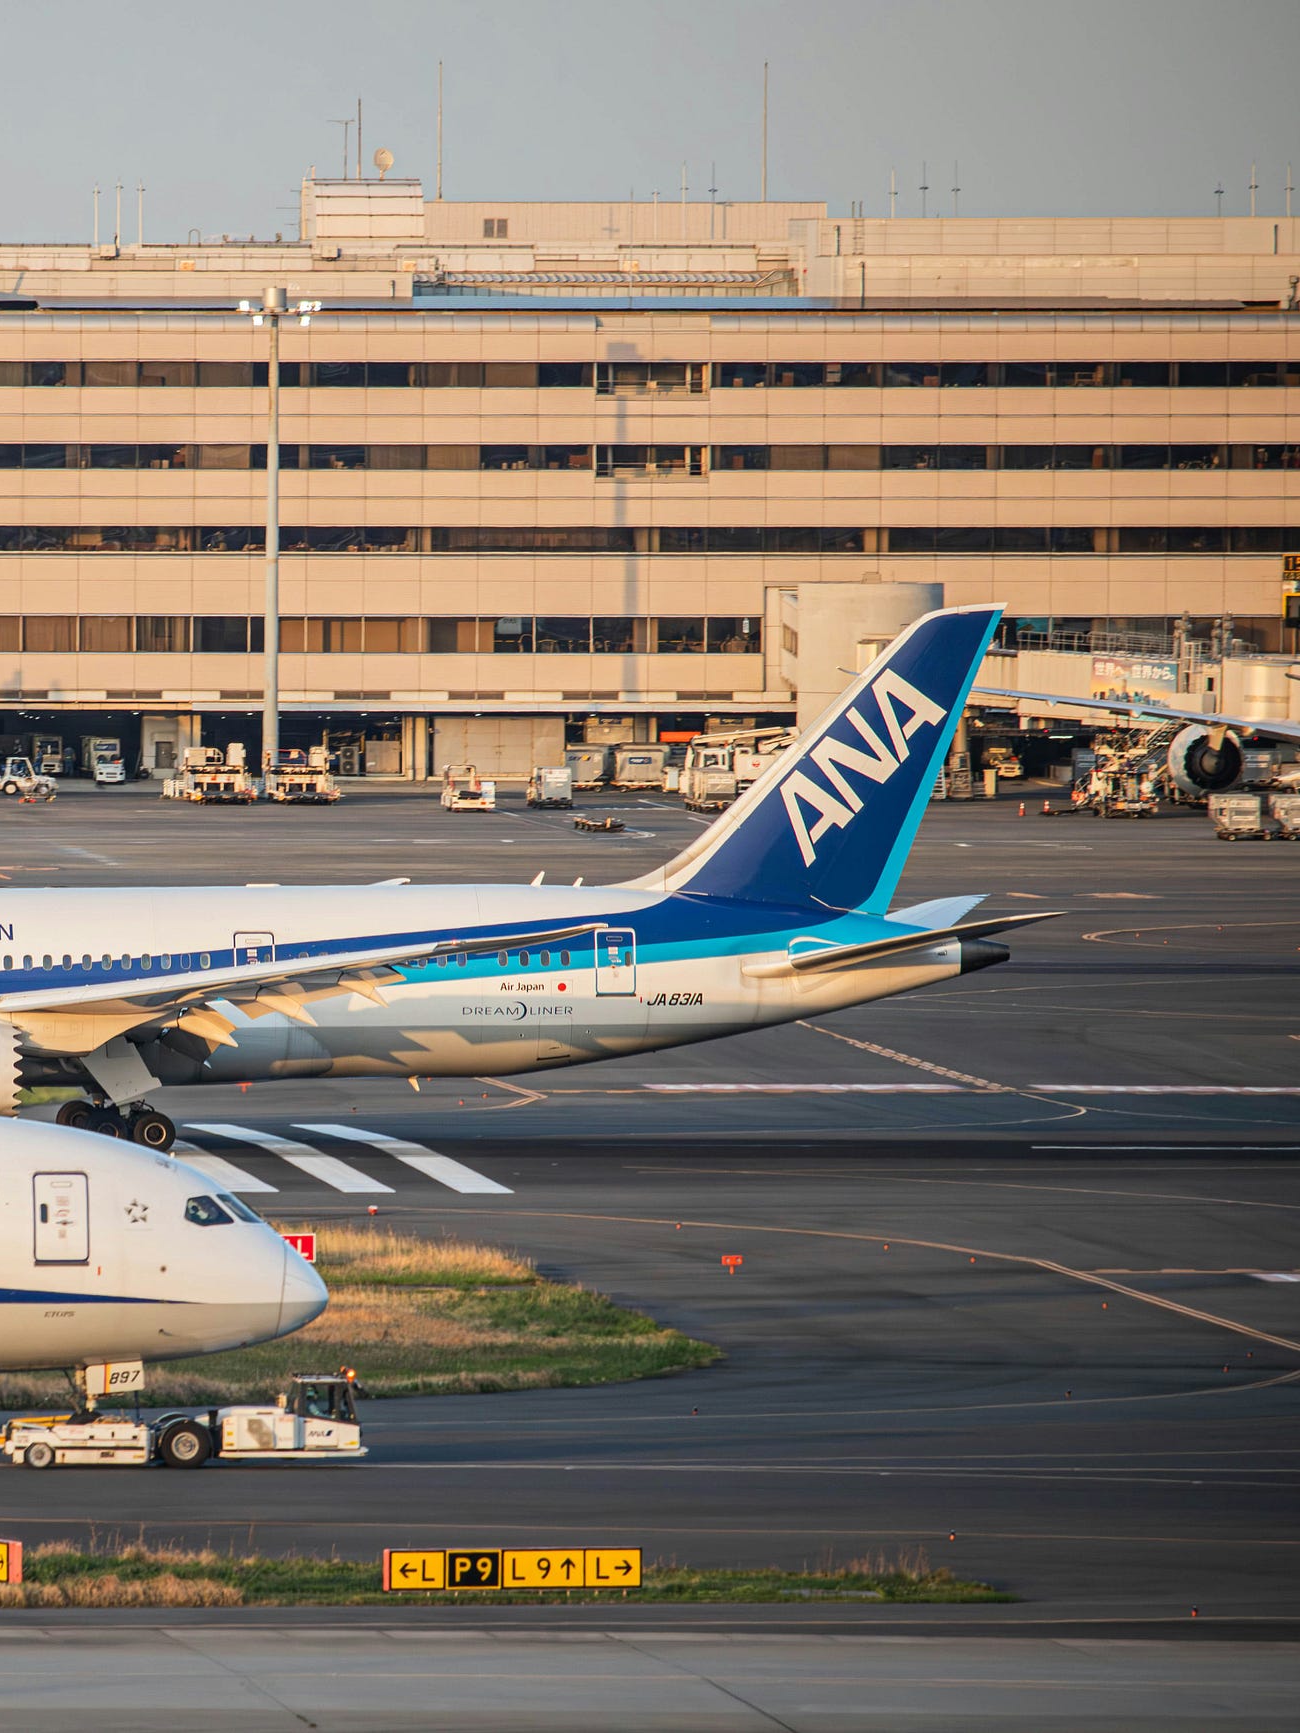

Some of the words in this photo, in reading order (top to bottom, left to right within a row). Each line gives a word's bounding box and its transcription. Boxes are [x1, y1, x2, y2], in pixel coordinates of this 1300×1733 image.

[779, 667, 948, 868] ANA
[499, 982, 515, 992] Air
[516, 982, 545, 993] Japan
[108, 1370, 141, 1385] 897
[422, 1559, 435, 1582] L
[454, 1557, 493, 1583] P9
[596, 1557, 610, 1580] L
